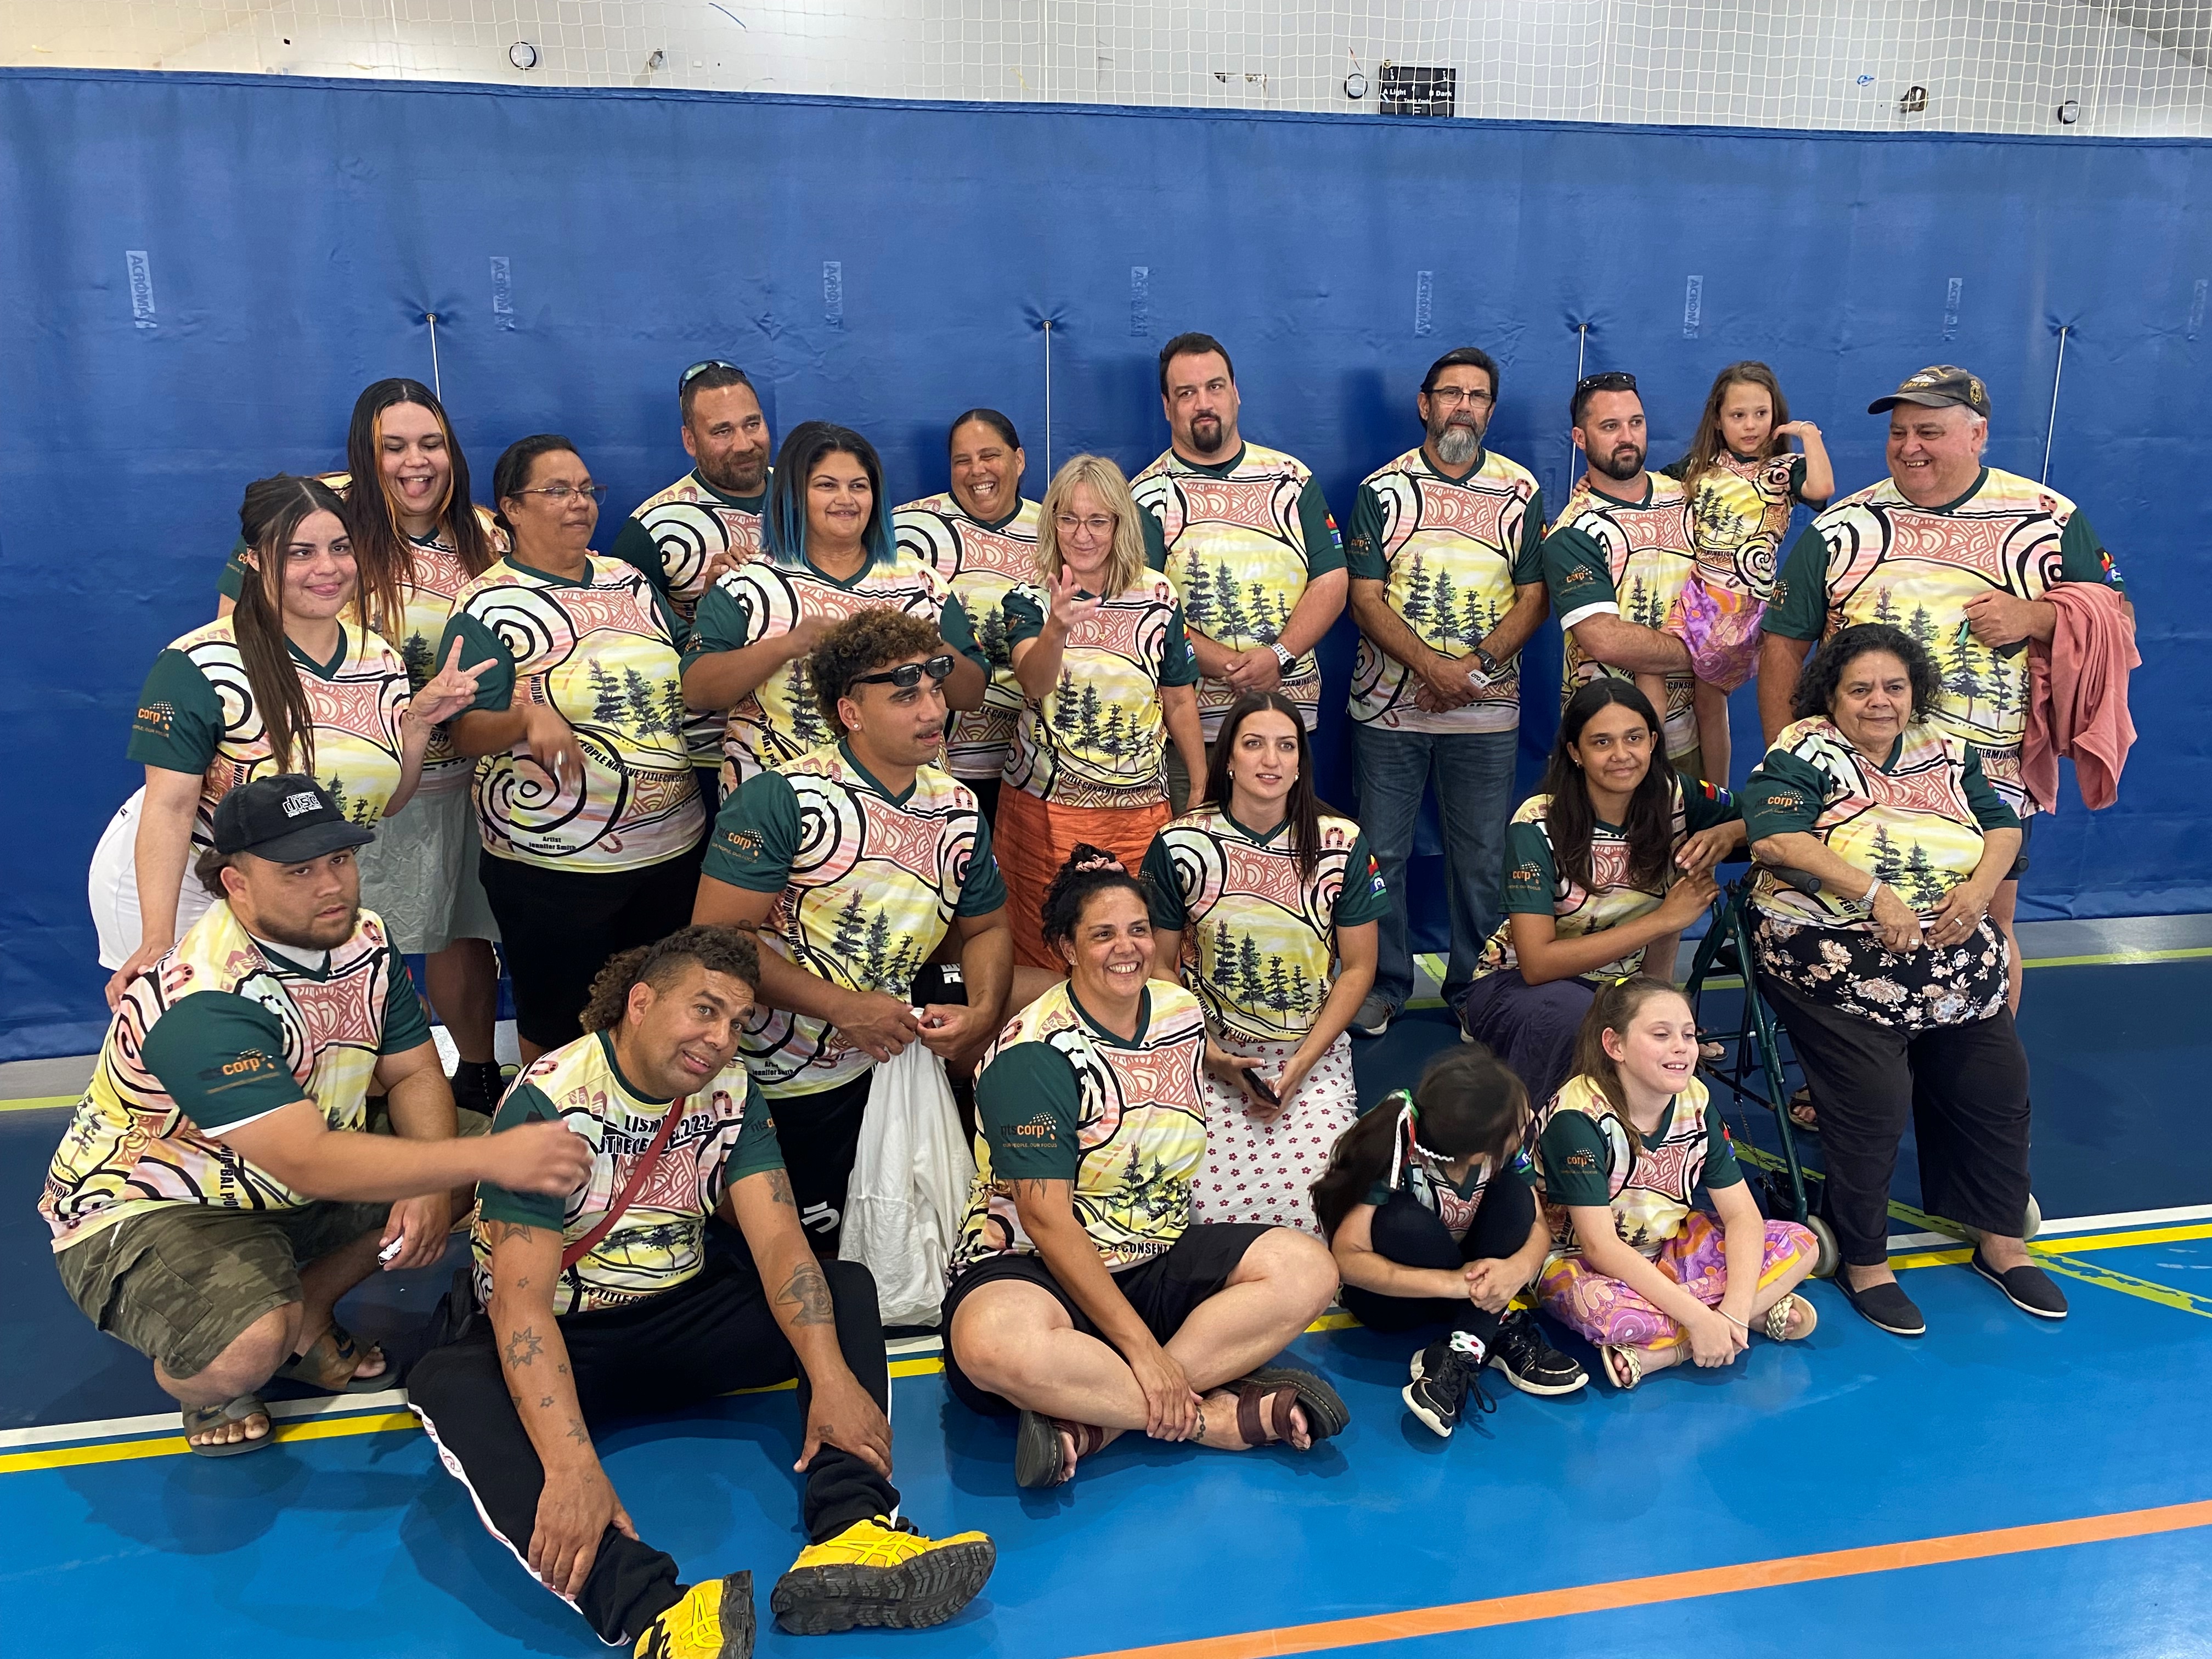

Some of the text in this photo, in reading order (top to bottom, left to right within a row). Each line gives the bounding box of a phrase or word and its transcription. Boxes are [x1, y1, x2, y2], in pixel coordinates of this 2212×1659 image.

[130, 255, 150, 318] ACROMA
[605, 758, 641, 778] NATIVE
[641, 770, 663, 782] TITLE
[1062, 772, 1083, 787] TITLE
[1082, 781, 1116, 795] CONSENT
[283, 795, 320, 813] disc
[1194, 992, 1213, 1018] PEOPLE
[597, 1290, 631, 1304] TITLE
